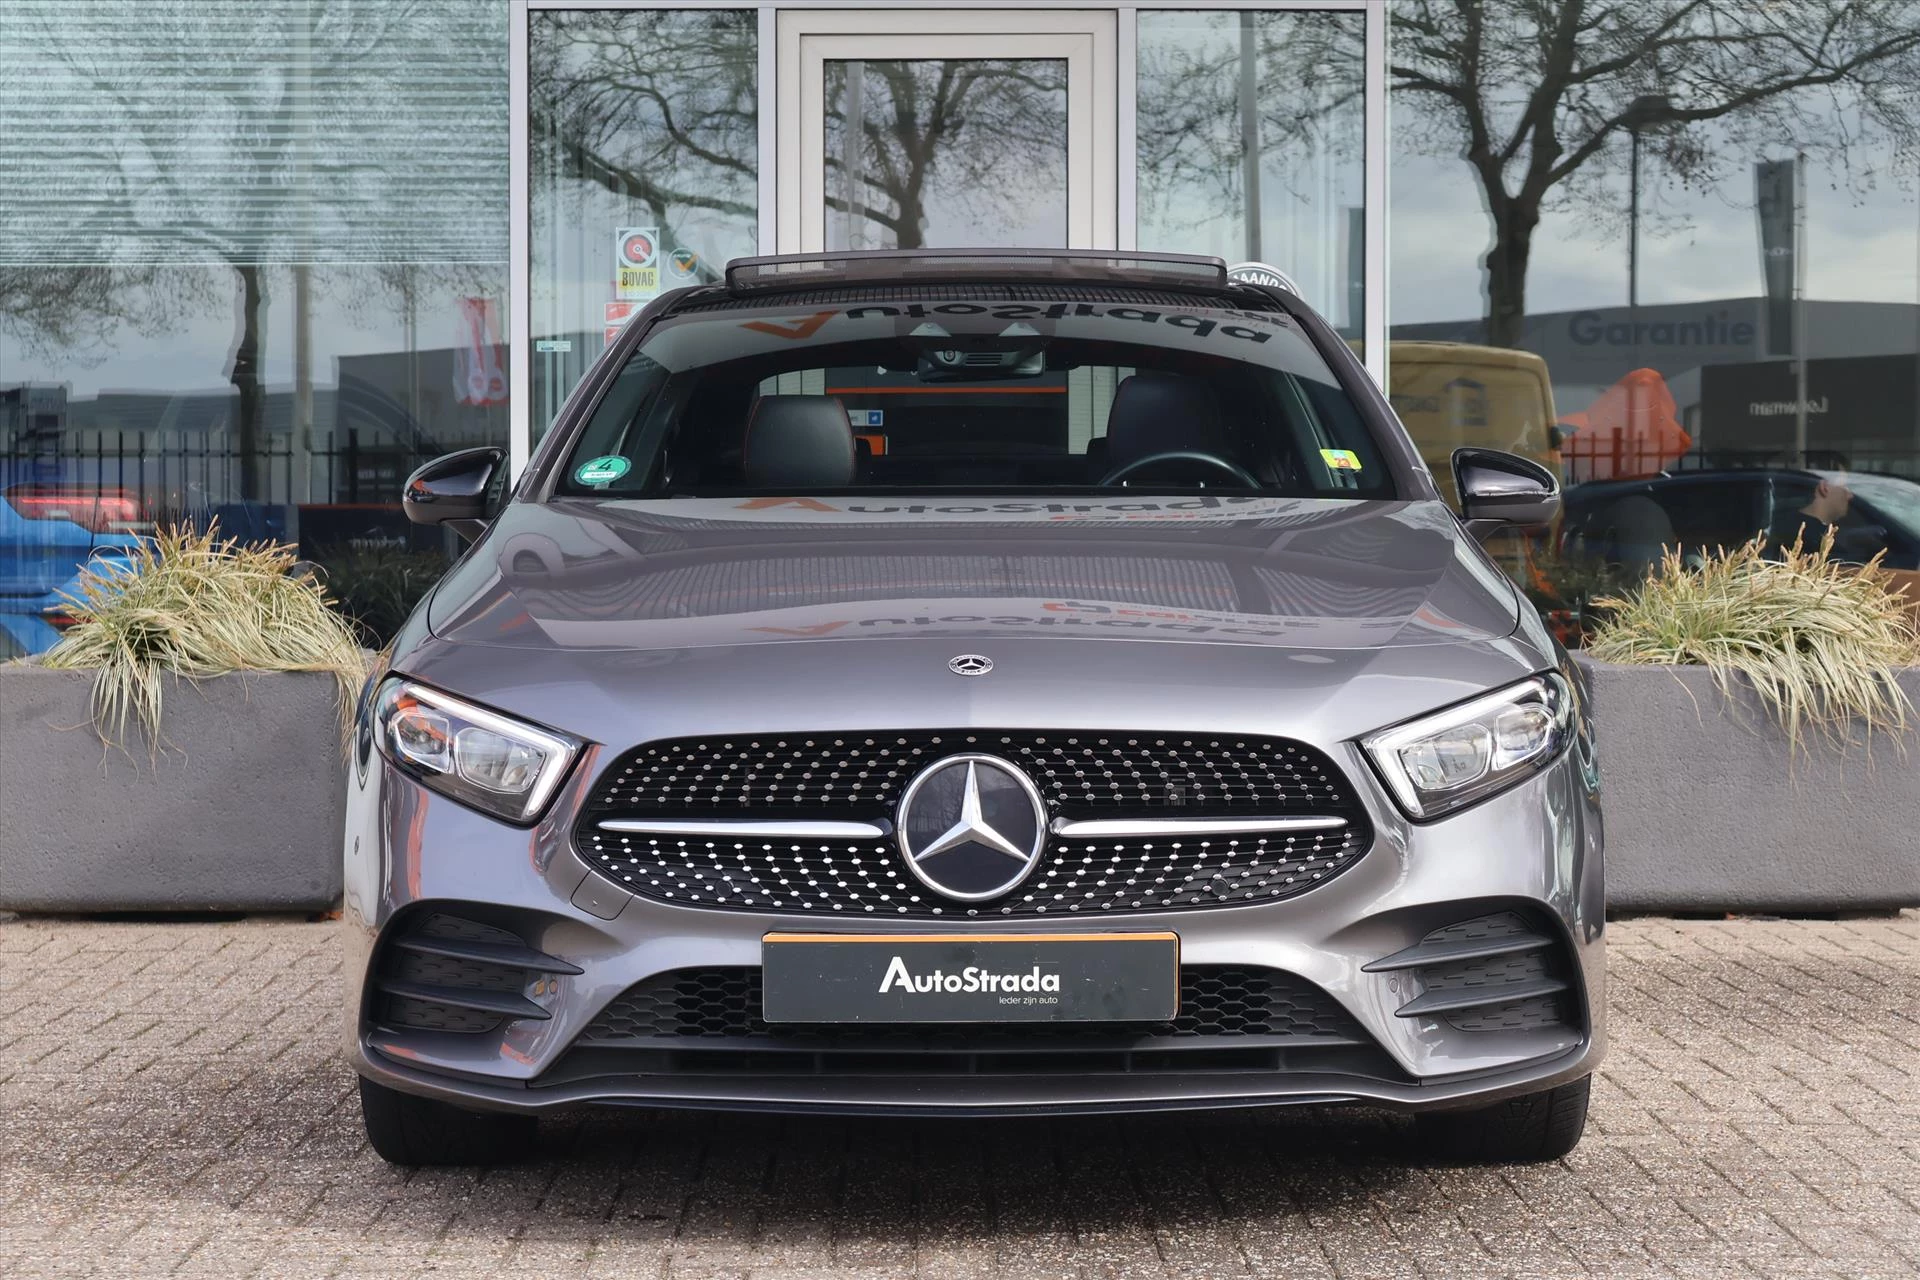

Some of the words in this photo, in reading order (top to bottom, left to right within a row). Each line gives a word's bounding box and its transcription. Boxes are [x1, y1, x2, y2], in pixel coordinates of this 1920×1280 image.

[622, 271, 654, 287] BOVAG
[1568, 309, 1756, 346] Garantie
[597, 459, 613, 471] 4
[878, 956, 1060, 993] AutoStrada
[1023, 996, 1037, 1006] zijn
[1039, 996, 1058, 1004] auto
